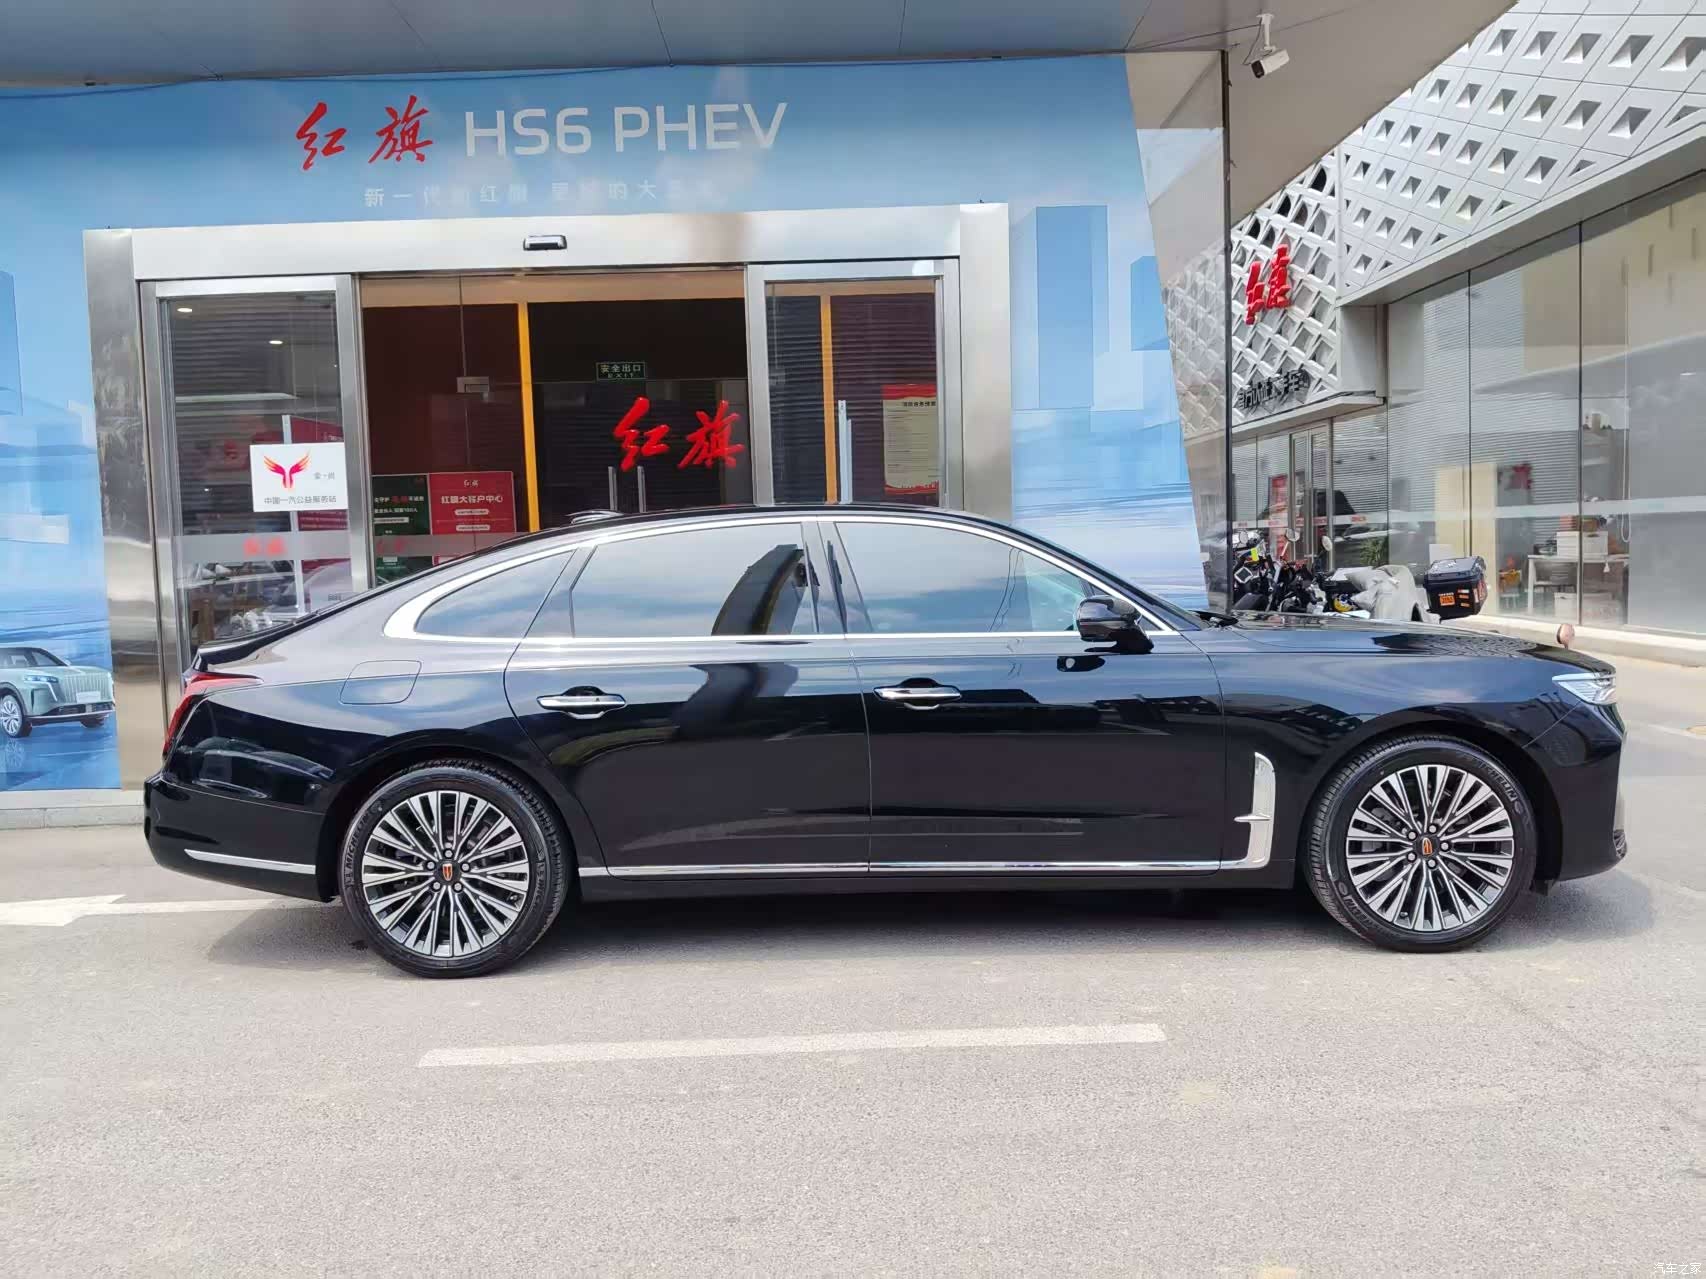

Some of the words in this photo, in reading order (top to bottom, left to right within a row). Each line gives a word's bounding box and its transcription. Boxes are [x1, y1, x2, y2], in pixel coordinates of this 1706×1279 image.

[296, 95, 433, 171] 红旗
[465, 107, 592, 157] HS6
[614, 102, 788, 153] PHEV
[600, 363, 641, 374] 安全出口
[613, 396, 746, 472] 红旗
[440, 495, 504, 504] 红旗大客户中心
